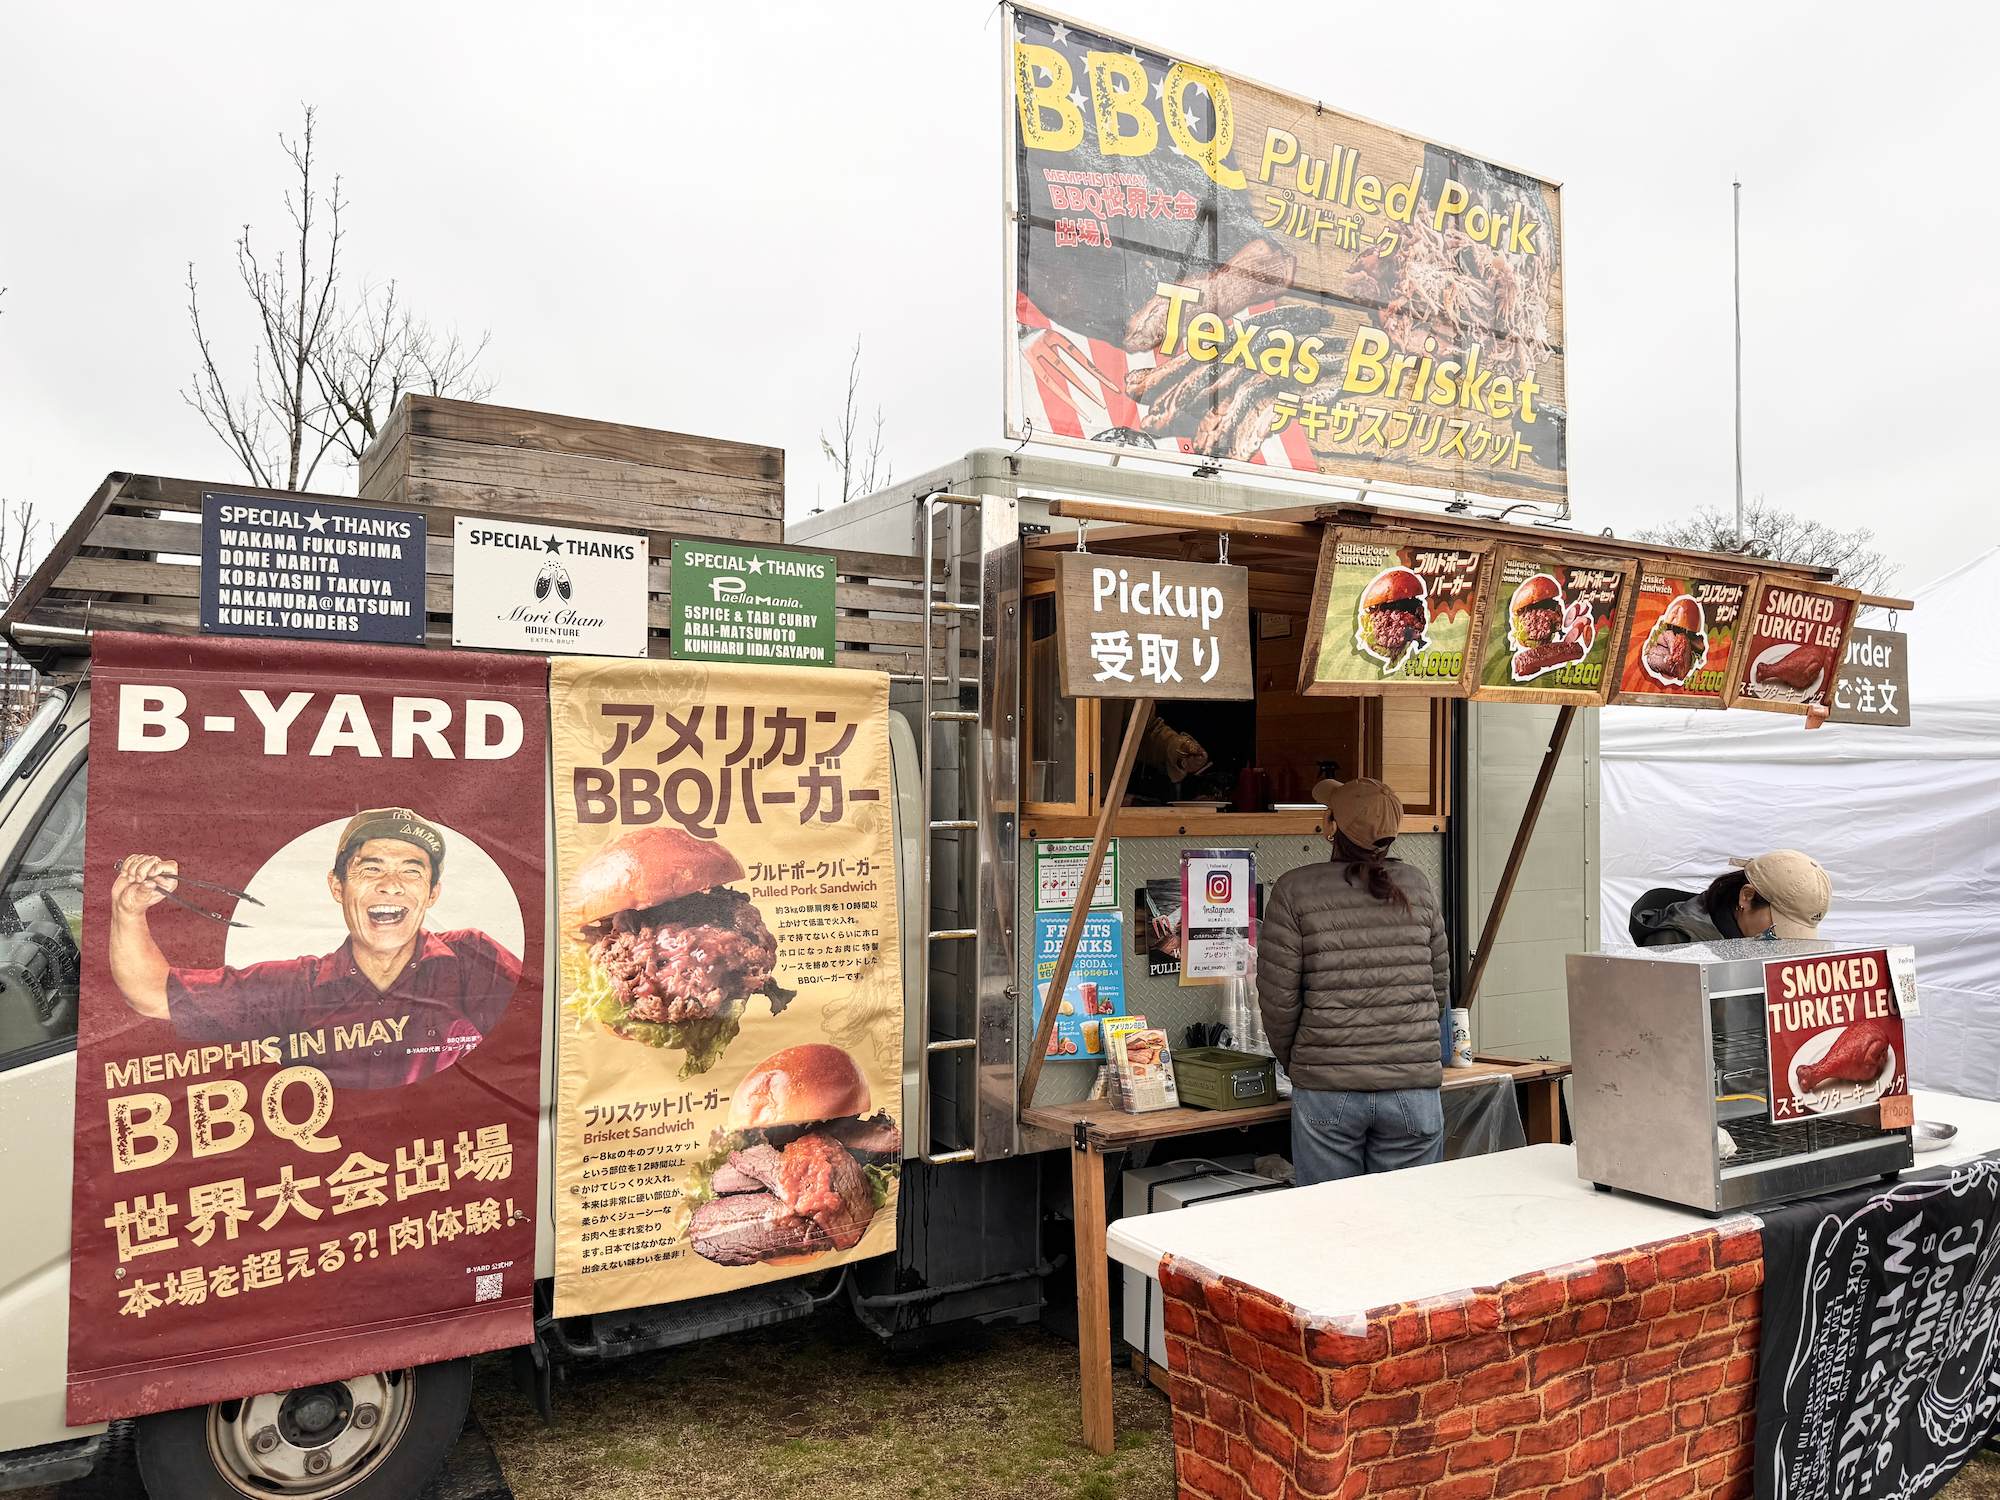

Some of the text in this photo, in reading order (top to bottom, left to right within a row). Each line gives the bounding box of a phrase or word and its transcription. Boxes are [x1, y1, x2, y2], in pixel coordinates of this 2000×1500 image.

[1016, 41, 1247, 190] BBQ
[1043, 168, 1147, 187] MEMPHIS IN MAY
[1258, 126, 1540, 254] Pulled Pork
[1048, 184, 1198, 220] BBQ世界大会
[1262, 190, 1399, 258] プルドポーク
[1156, 281, 1541, 424] Texas Brisket
[1270, 391, 1533, 470] テキサスブリスケット
[220, 506, 411, 538] SPECIAL THANKS
[220, 529, 402, 559] WAKANA FUKUSHIMA
[470, 530, 634, 560] SPECIAL THANKS
[220, 549, 340, 573] DOME NARITA
[685, 552, 824, 579] SPECIAL THANKS
[1335, 552, 1383, 567] Sandwich
[1413, 552, 1480, 575] プルドポーク
[219, 568, 392, 596] KOBAYASHI TAKUYA
[1429, 575, 1473, 596] バーガー
[1568, 570, 1621, 589] プルドポーク
[219, 589, 411, 616] NAKAMURA@KATSUMI
[1092, 567, 1224, 630] Pickup
[1697, 584, 1743, 603] ブリスケット
[1766, 589, 1834, 623] SMOKED
[218, 608, 359, 631] KUNEL.YONDERS
[497, 605, 606, 627] Mori Cham
[685, 605, 817, 628] 5SPICE & TABI CURRY
[1716, 605, 1739, 622] サンド
[525, 625, 581, 637] ADVENTURE
[684, 622, 796, 643] ARAI-MATSUMOTO
[1753, 614, 1841, 648] TURKEY LEG
[685, 639, 825, 660] KUNIHARU IIDA/SAYAPON
[1090, 629, 1220, 684] 受取り
[1738, 681, 1825, 703] スモークターキーレッグ
[1834, 676, 1899, 715] ご注文
[117, 684, 525, 760] B-YARD
[601, 703, 858, 767] アメリカン
[574, 757, 880, 839] BBQバーガー
[749, 857, 880, 882] プルドポークバーガー
[752, 880, 877, 898] Pulled Pork Sandwich
[777, 916, 860, 929] 上かけて低温で火入れ。
[1203, 905, 1235, 917] Instagram
[778, 929, 879, 943] 手で持てないくらいにホロ
[1046, 924, 1111, 938] FRITS
[1043, 940, 1113, 953] DNKS
[1080, 960, 1107, 968] SODA
[797, 972, 864, 985] BBQバーガーです。
[1781, 957, 1879, 999] SMOKED
[1768, 992, 1856, 1034] TURKEY
[104, 1015, 411, 1090] MEMPHIS IN MAY
[584, 1089, 730, 1128] ブリスケットバーガー
[1776, 1075, 1905, 1117] スモークターキーレッグ
[107, 1065, 342, 1173] BBQ
[583, 1118, 695, 1145] Brisket Sandwich
[582, 1158, 686, 1179] という部位を12時間以上
[105, 1123, 513, 1262] 世界大会出場
[581, 1174, 675, 1195] かけてじっくり火入れ。
[581, 1189, 684, 1210] 本来は非常に硬い部位が、
[581, 1206, 672, 1226] 柔らかくジューシーな
[581, 1222, 662, 1242] お肉へ生まれ変わり
[582, 1236, 676, 1259] ます。日本ではなかなか
[466, 1261, 513, 1274] B-YARD 公式HP
[1845, 1227, 1869, 1298] JACK
[1891, 1232, 1936, 1352] SOUR
[1832, 1294, 1844, 1332] LEM
[1839, 1279, 1871, 1402] DISTILLED AND
[1824, 1307, 1853, 1410] DANIEL
[1834, 1210, 1924, 1500] WHISKE
[1796, 1431, 1810, 1450] IN
[1789, 1453, 1805, 1491] 1866
